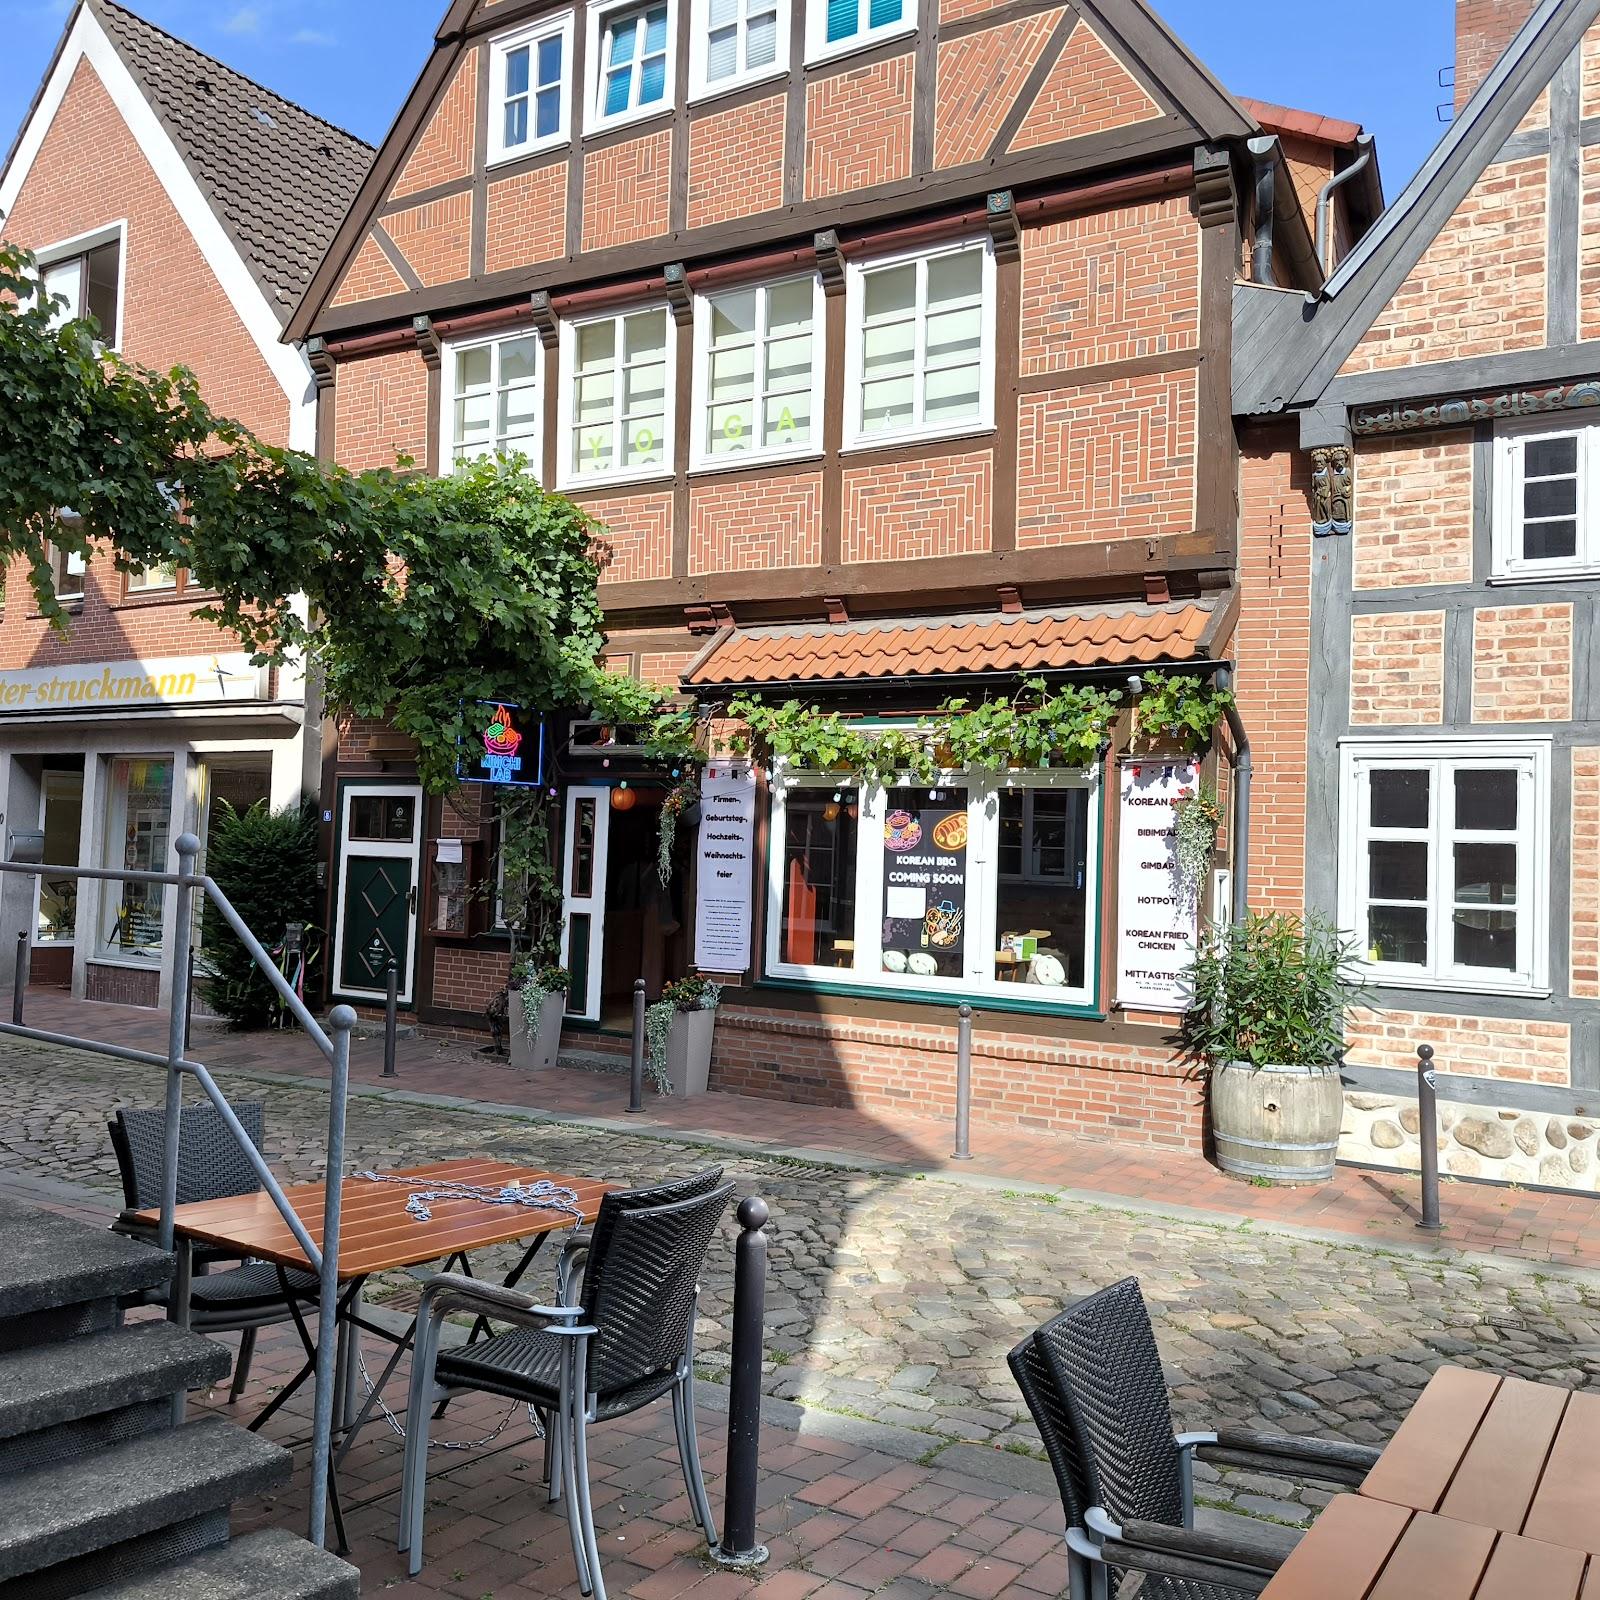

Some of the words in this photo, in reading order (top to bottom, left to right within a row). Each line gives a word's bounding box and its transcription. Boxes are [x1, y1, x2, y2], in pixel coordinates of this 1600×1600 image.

[481, 754, 521, 770] KIMCHI
[490, 768, 511, 781] LAB
[1128, 798, 1168, 806] KOREAN
[896, 855, 935, 866] KOREAN
[936, 856, 957, 867] BBQ
[717, 870, 732, 878] feier
[888, 872, 930, 884] COMING
[932, 873, 964, 885] SOON
[1137, 896, 1177, 905] HOTPOT
[1126, 929, 1161, 938] KOREAN
[1163, 931, 1189, 940] FRIED
[1138, 941, 1176, 951] CHICKEN
